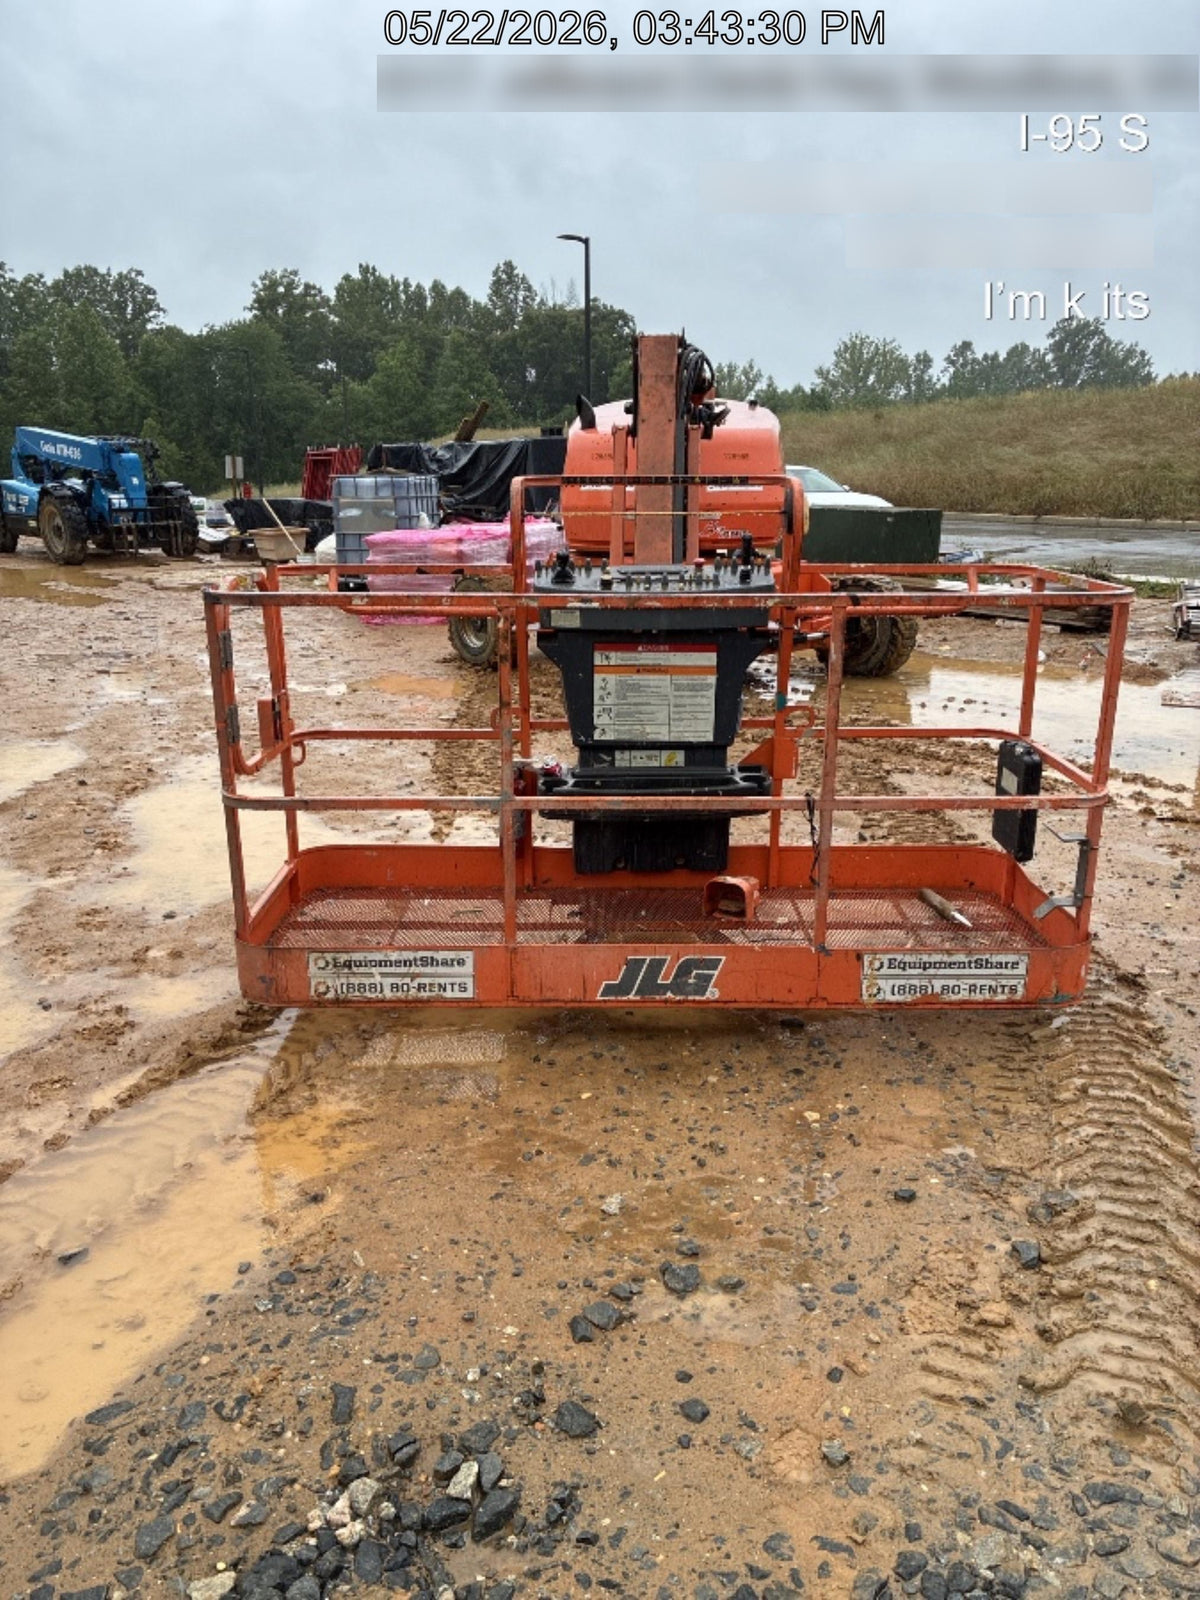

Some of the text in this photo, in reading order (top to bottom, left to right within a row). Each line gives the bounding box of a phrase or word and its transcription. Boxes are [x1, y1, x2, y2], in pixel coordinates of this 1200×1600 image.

[332, 956, 466, 970] EquipmentShare
[887, 957, 1020, 973] EquipmentShare
[596, 956, 726, 999] JLG
[340, 982, 468, 994] (888) 80-RENTS
[891, 984, 1018, 996] (888) 80-RENTS
